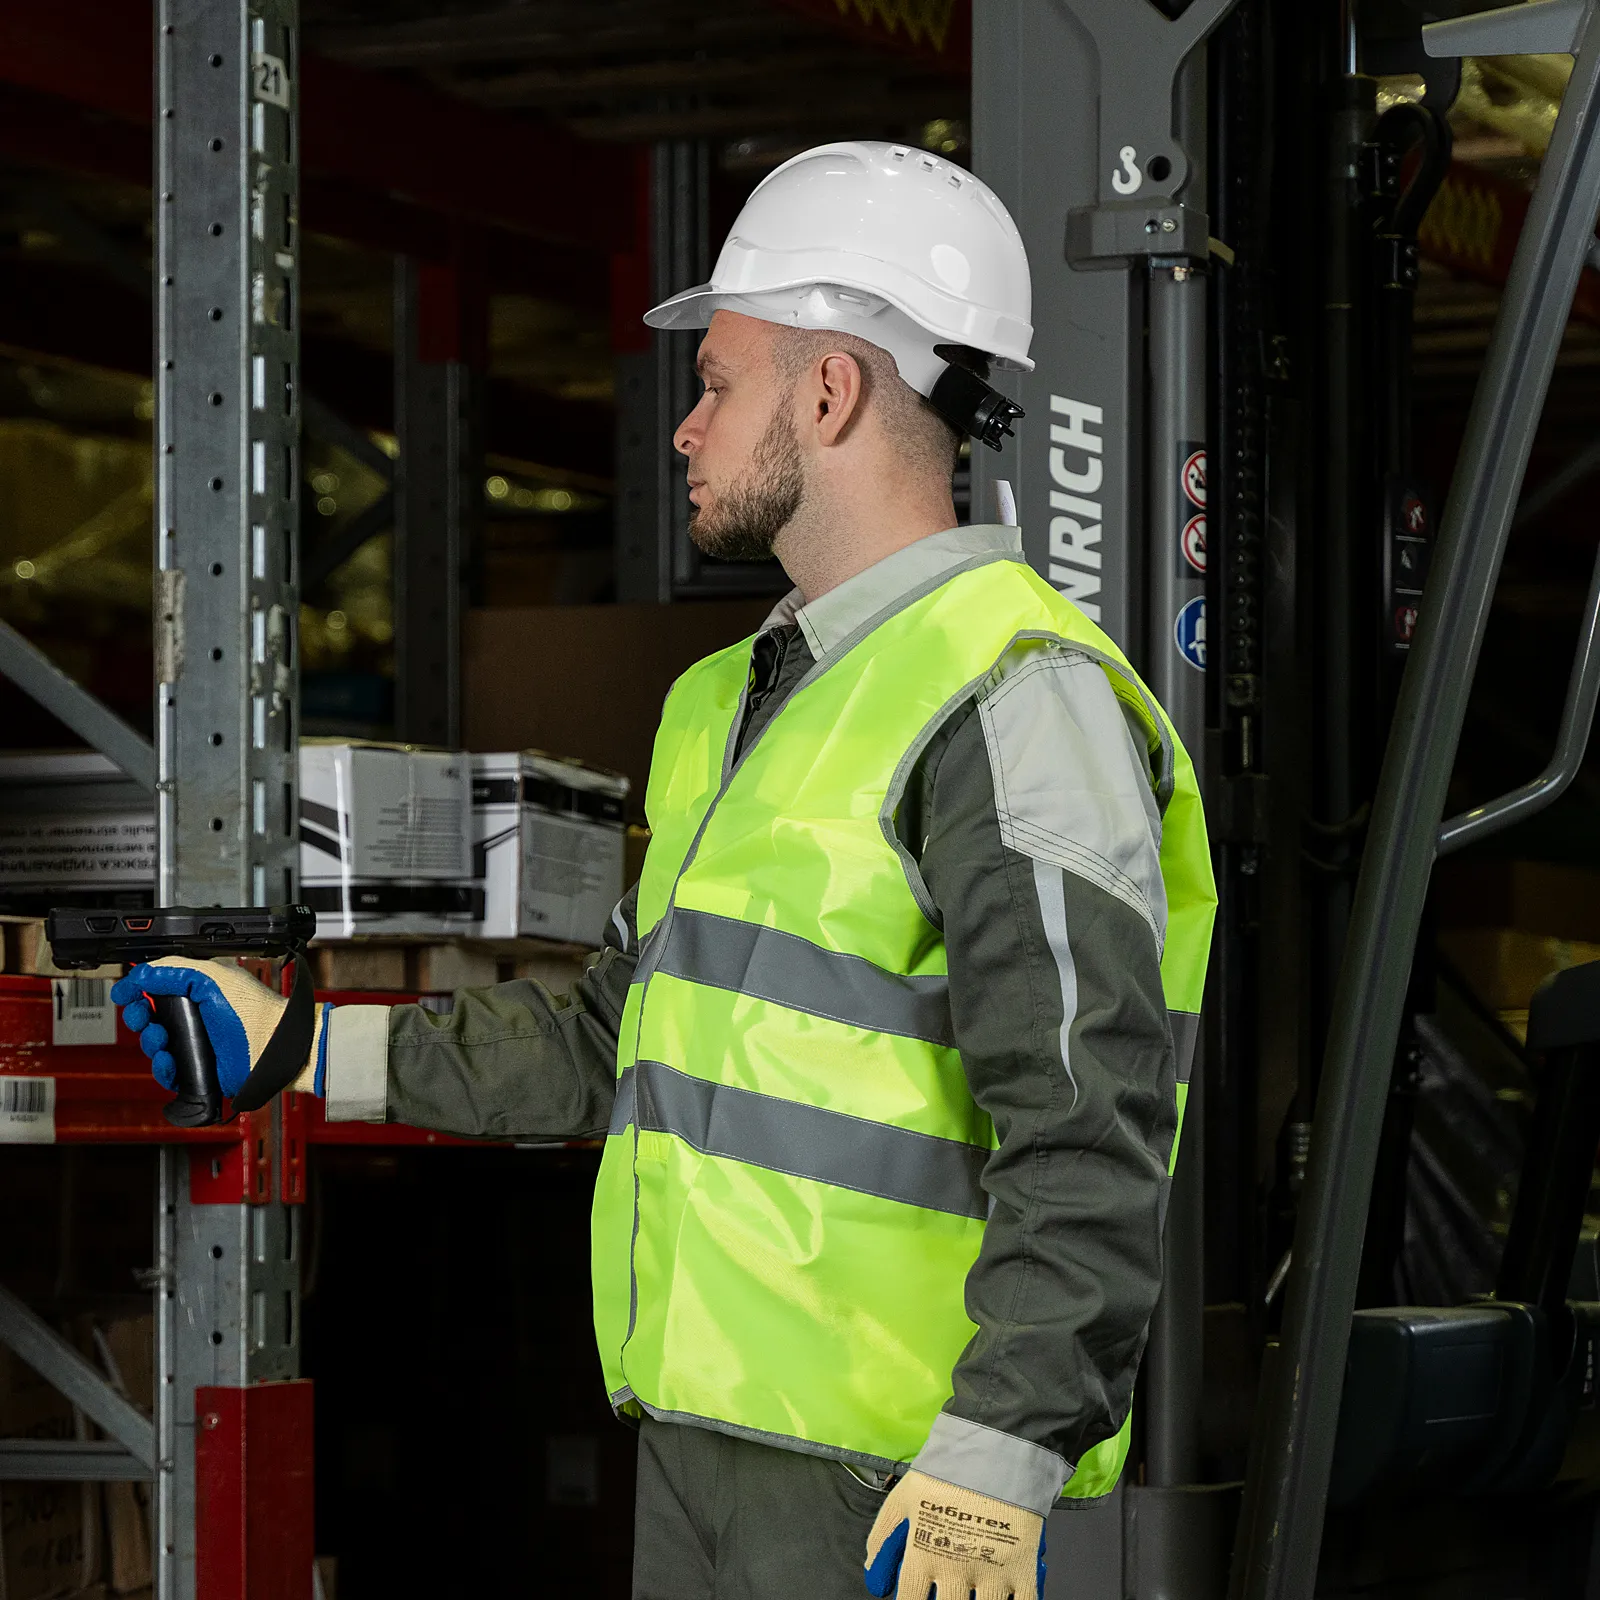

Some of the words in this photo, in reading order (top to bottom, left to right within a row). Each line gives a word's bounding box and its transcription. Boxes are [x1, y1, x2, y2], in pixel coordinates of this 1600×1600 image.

[261, 61, 280, 96] 21
[1049, 394, 1103, 622] NRICH
[920, 1500, 1011, 1531] сибртех
